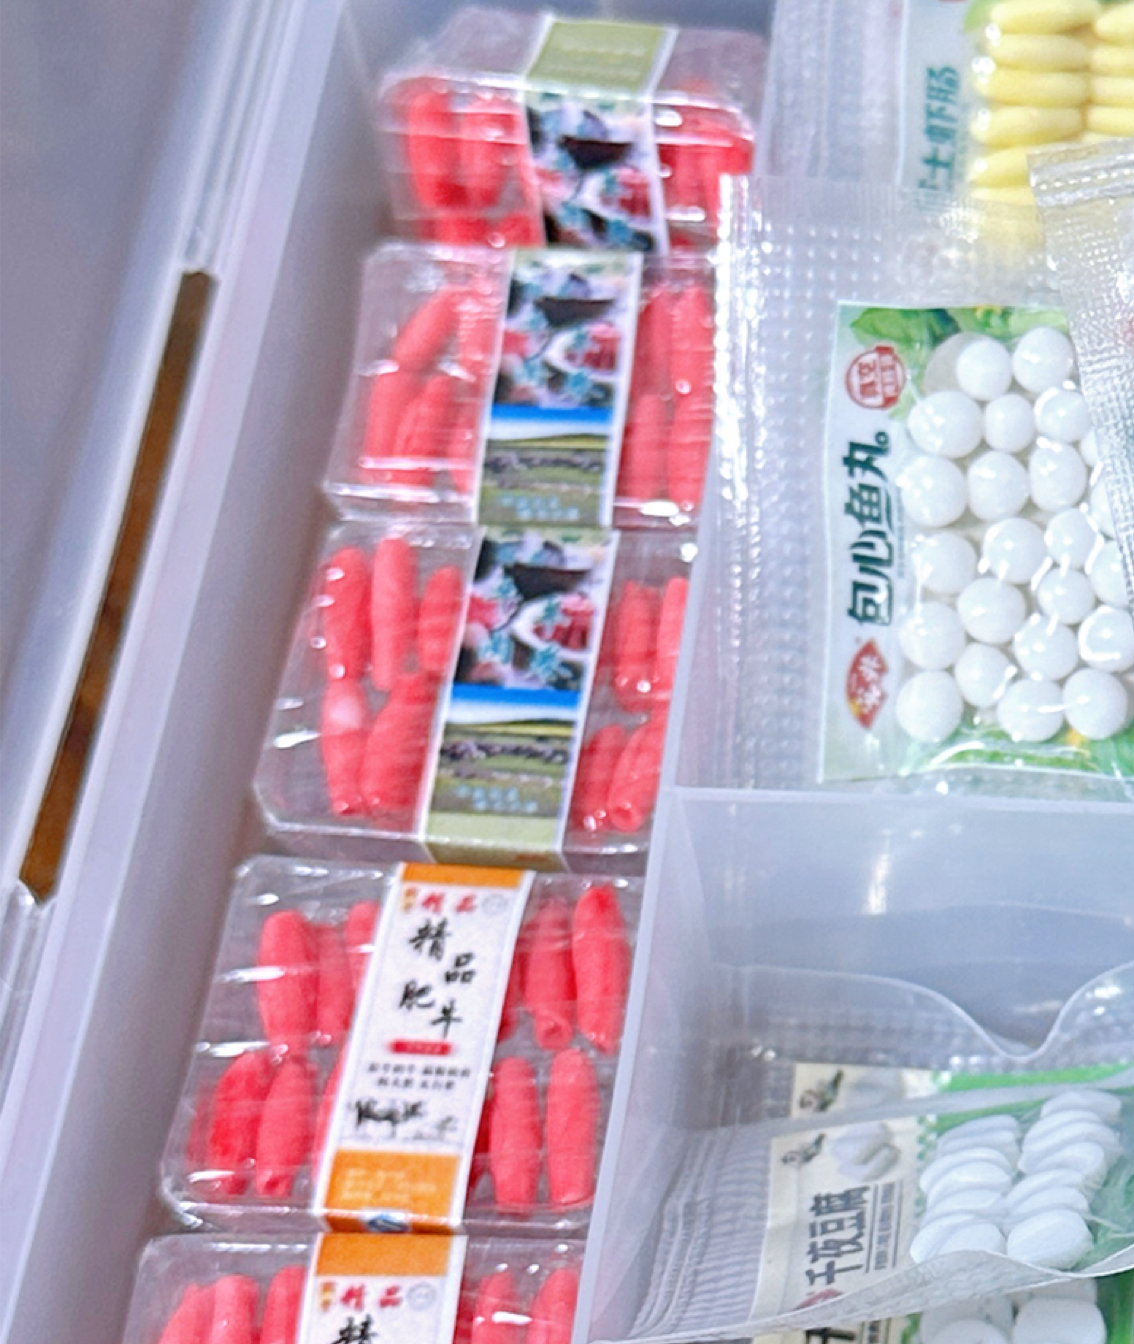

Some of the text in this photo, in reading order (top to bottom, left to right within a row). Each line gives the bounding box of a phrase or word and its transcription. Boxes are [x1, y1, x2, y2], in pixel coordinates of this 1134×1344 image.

[842, 431, 894, 627] 包心鱼丸
[805, 1184, 872, 1286] 千夜豆腐
